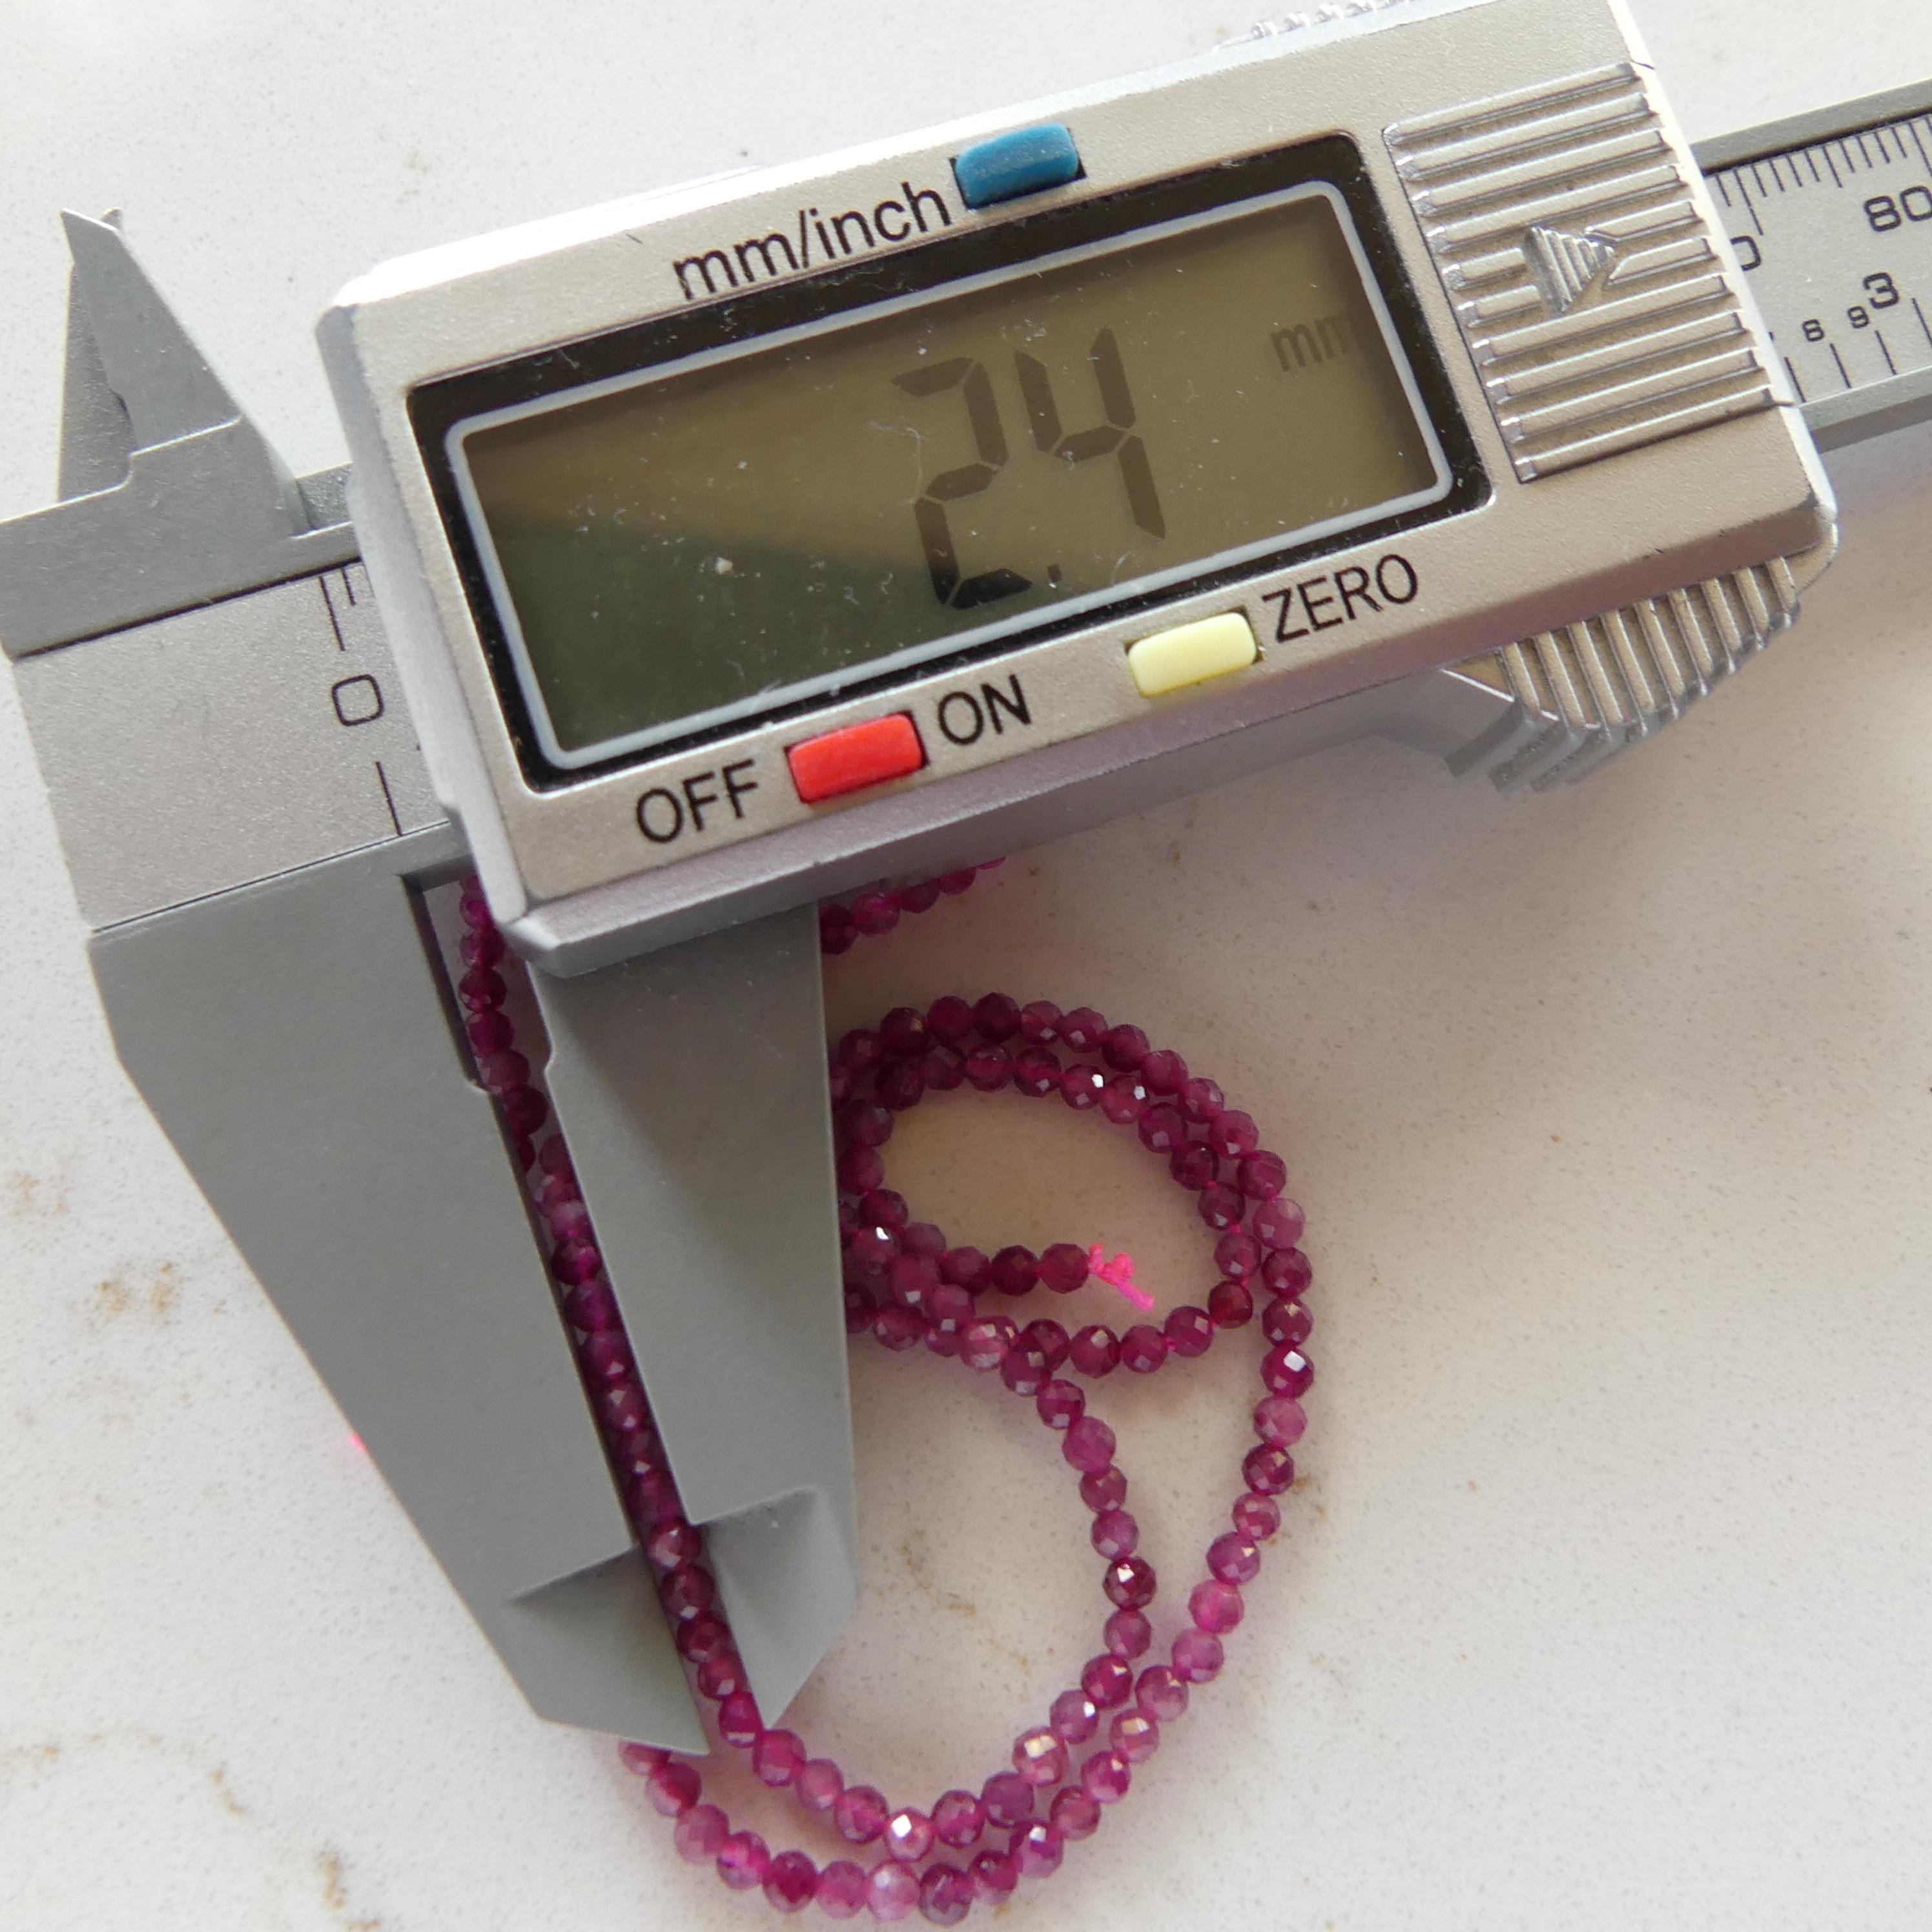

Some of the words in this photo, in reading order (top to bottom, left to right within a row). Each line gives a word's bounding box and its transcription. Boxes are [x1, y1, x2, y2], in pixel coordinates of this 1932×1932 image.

[1864, 185, 1932, 232] 80
[673, 181, 952, 300] mm/inch
[1847, 305, 1870, 329] 9
[1862, 272, 1900, 309] 3
[1261, 554, 1418, 643] ZERO
[331, 673, 385, 727] 0
[635, 758, 758, 845] OFF
[937, 673, 1032, 746] ON
